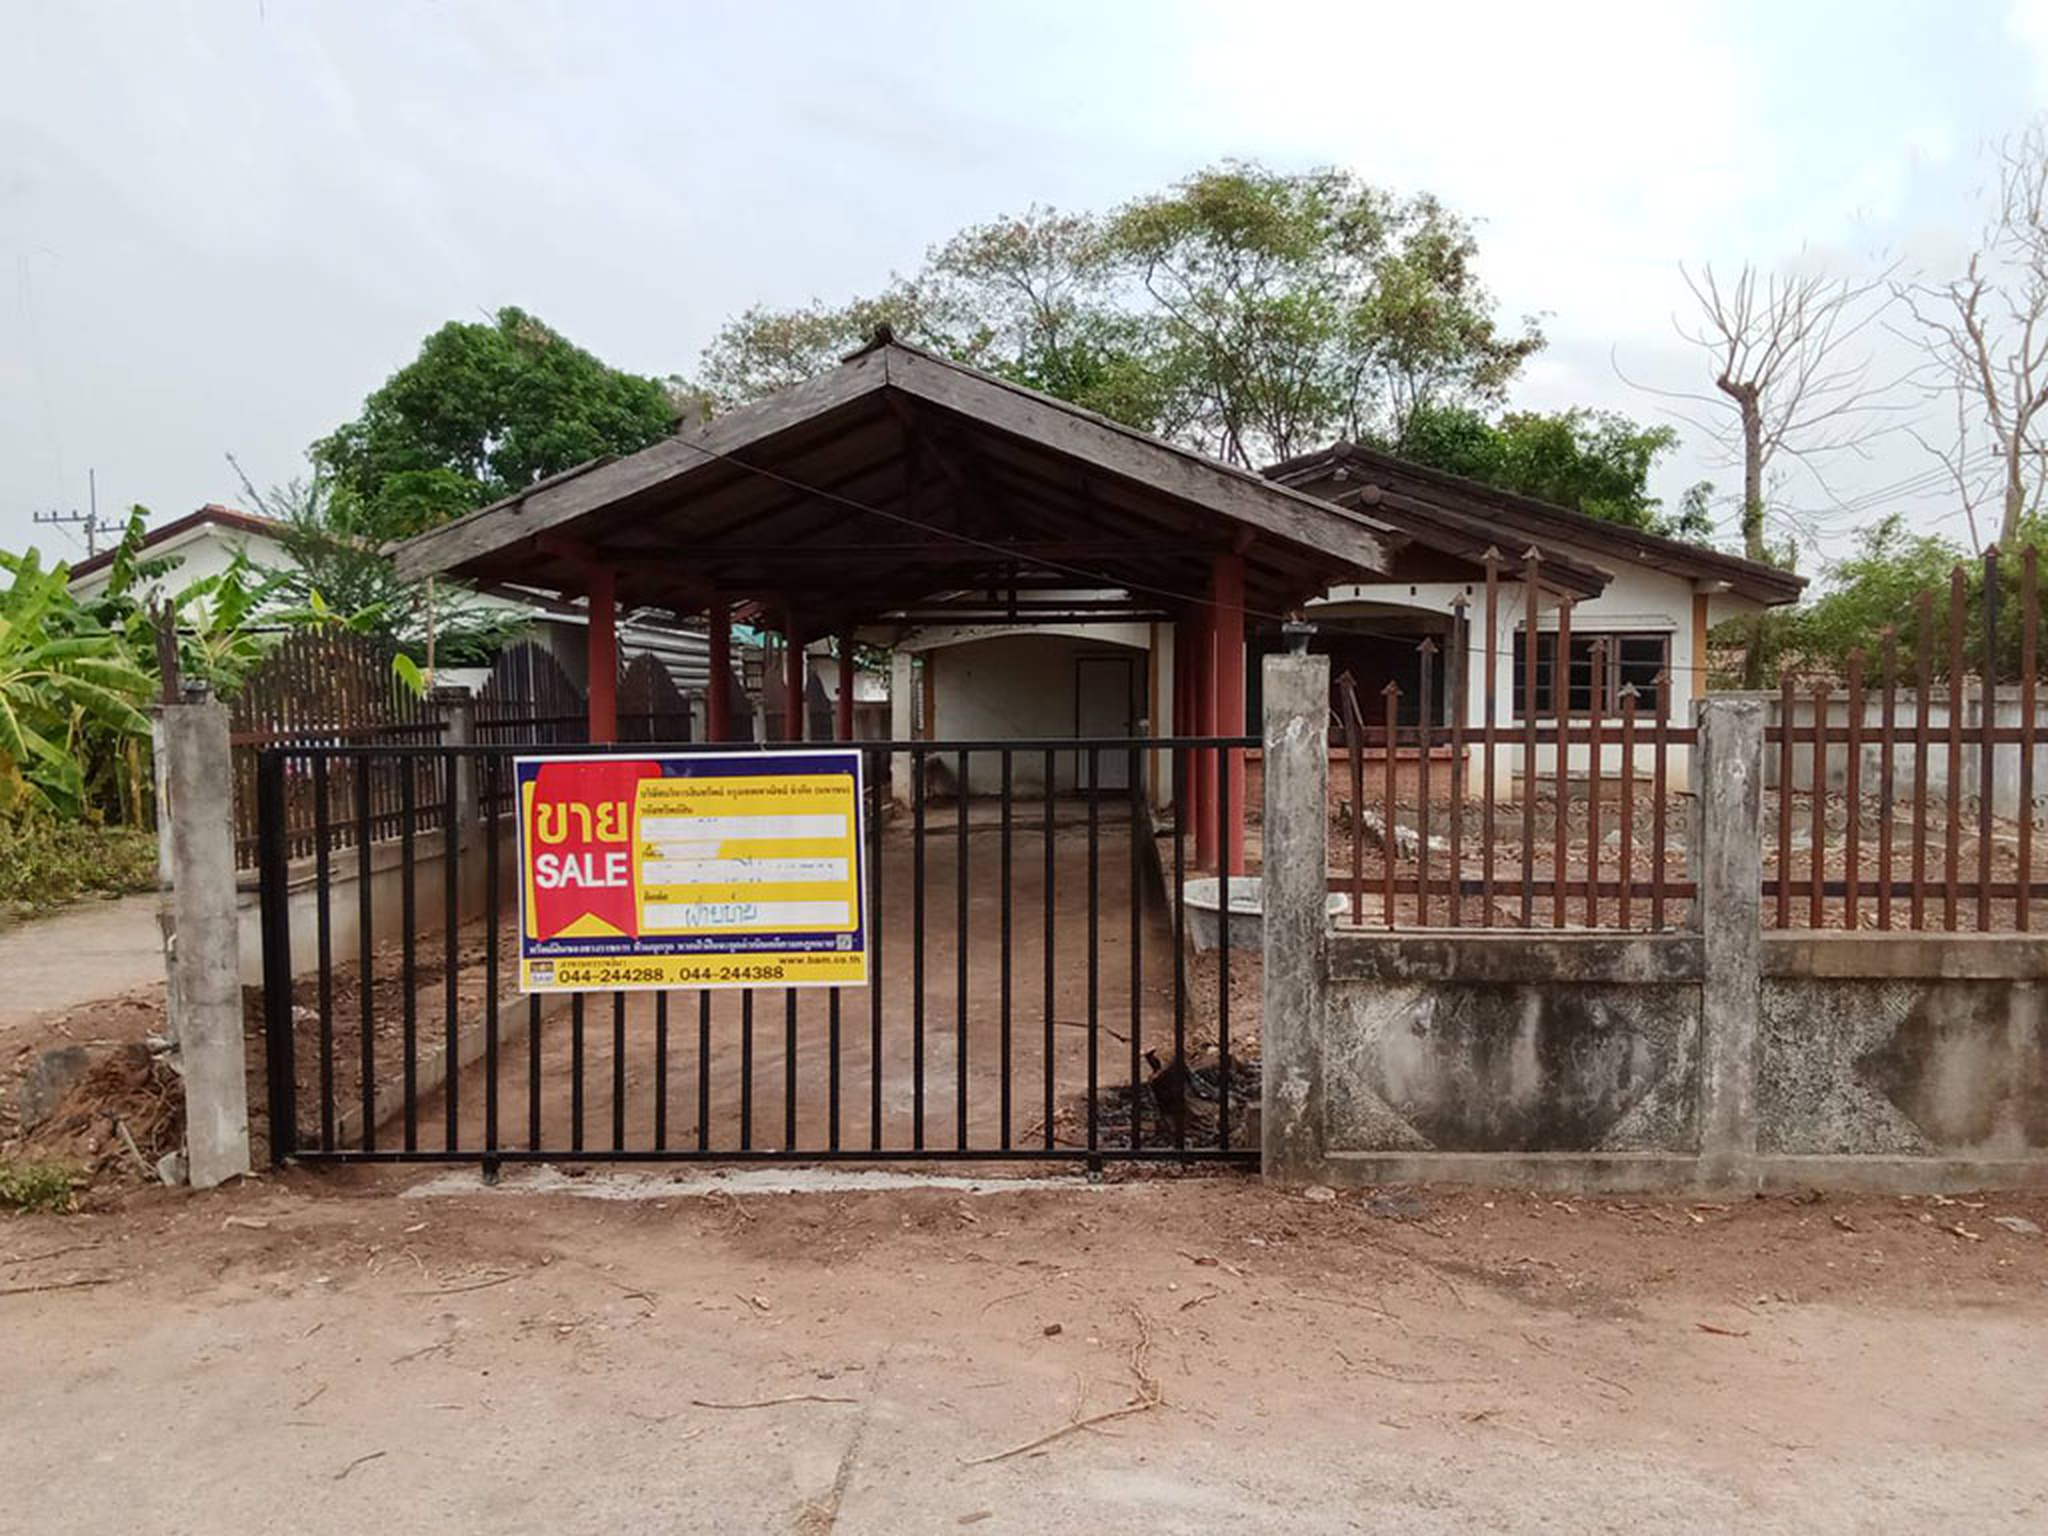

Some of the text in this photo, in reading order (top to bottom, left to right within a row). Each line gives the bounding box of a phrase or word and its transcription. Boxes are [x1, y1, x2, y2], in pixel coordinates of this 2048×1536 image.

[537, 801, 628, 844] ขาย
[536, 852, 628, 889] SALE
[559, 968, 664, 983] 044-244288
[679, 965, 784, 981] 044-244388
